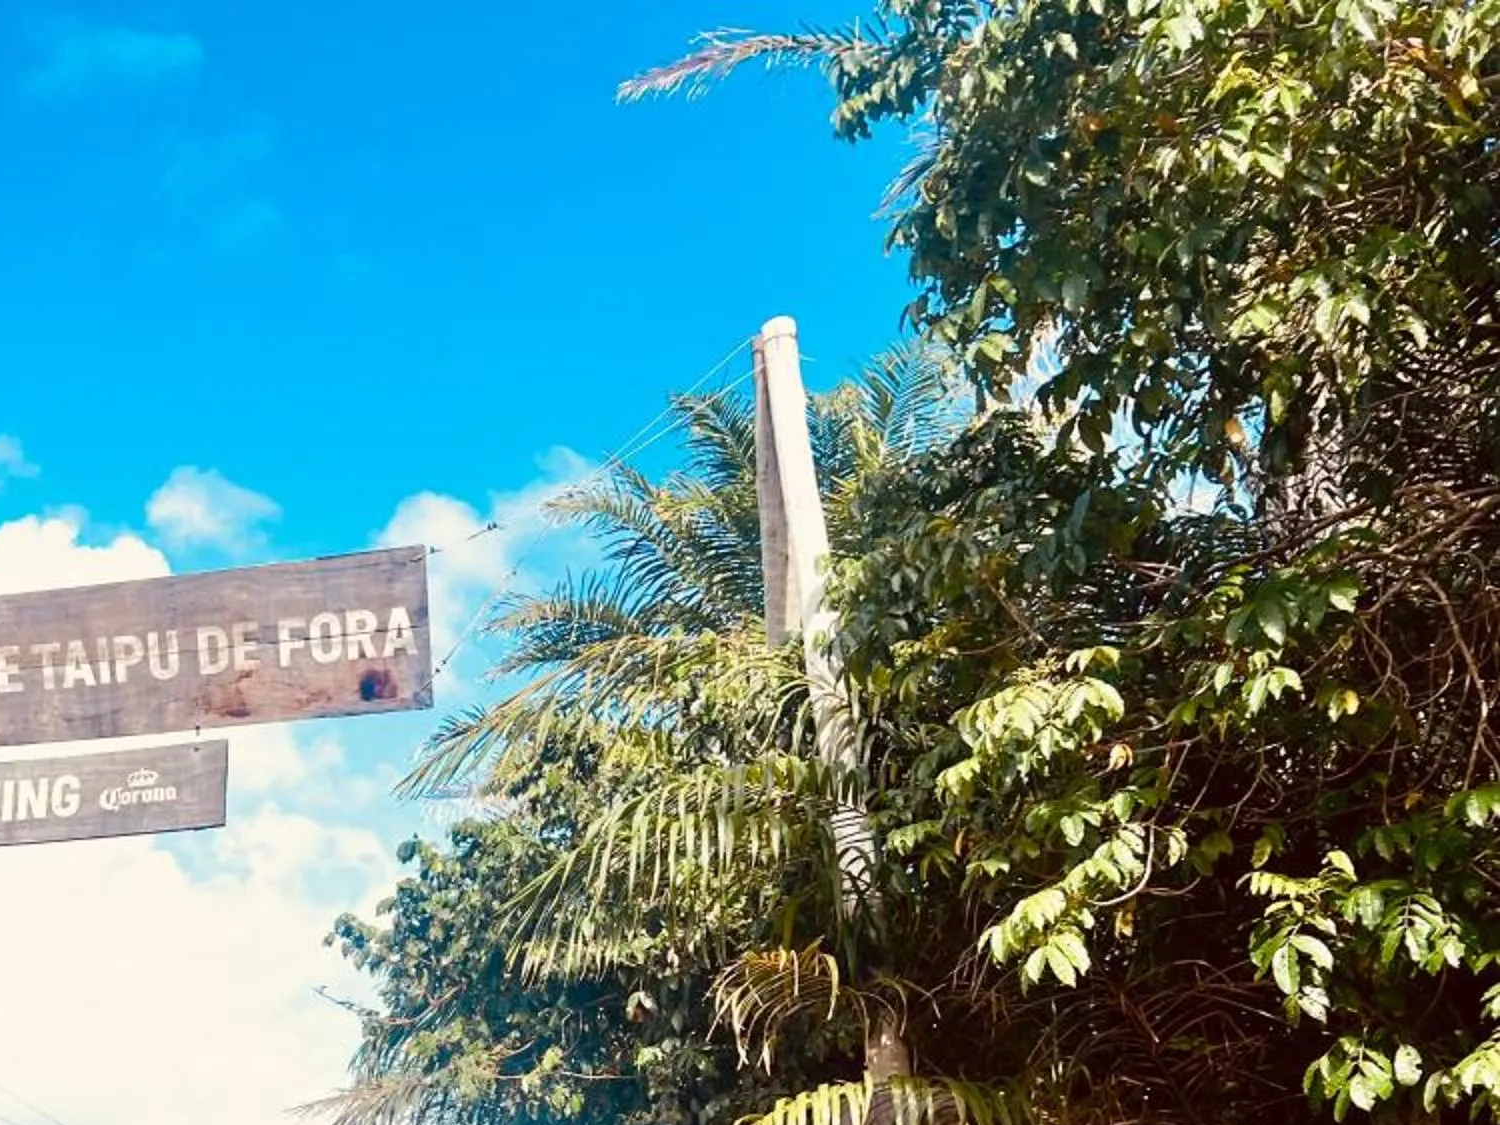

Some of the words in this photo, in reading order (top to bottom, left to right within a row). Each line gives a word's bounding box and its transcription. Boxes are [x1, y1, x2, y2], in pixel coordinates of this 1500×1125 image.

[30, 629, 180, 691] TAIPU
[196, 621, 262, 676] DE
[276, 606, 419, 667] FORA
[99, 785, 177, 812] Corona
